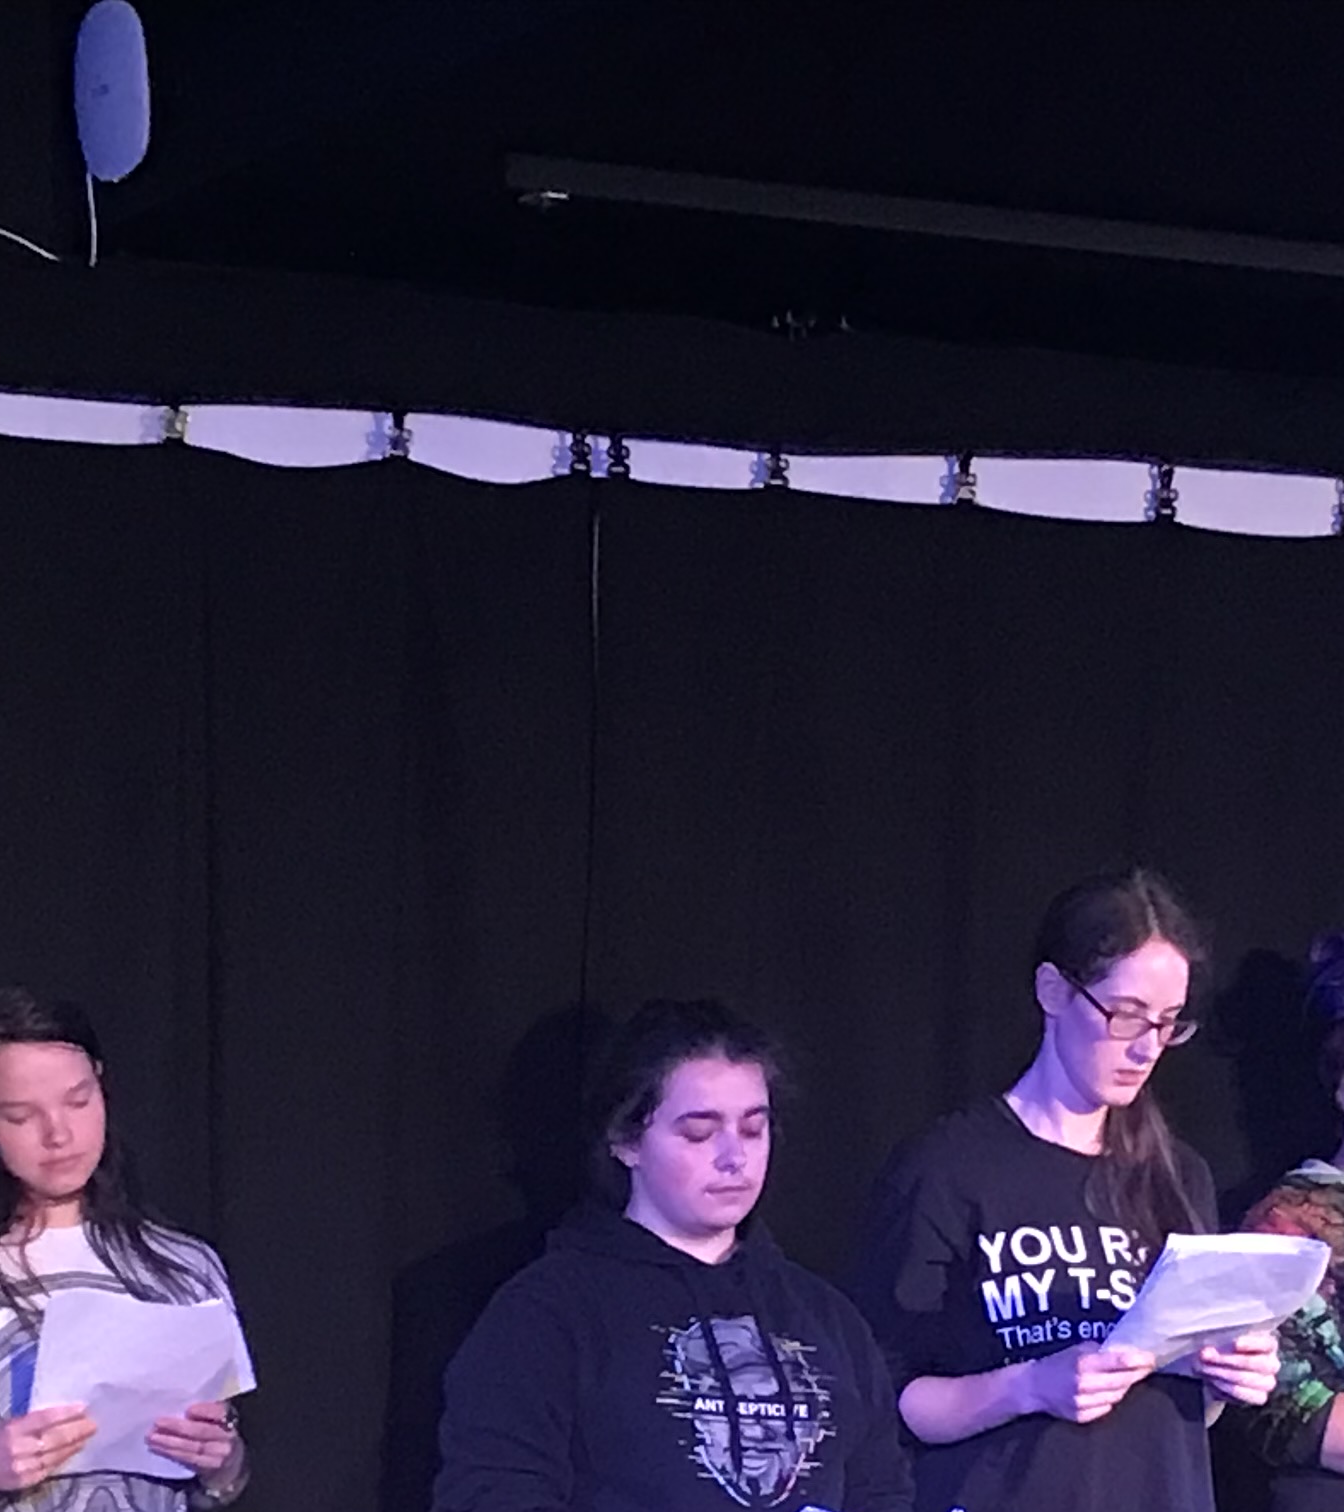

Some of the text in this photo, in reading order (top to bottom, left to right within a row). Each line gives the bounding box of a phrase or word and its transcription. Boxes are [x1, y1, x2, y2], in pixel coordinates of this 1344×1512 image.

[978, 1225, 1087, 1274] YOU
[981, 1267, 1137, 1323] MY T-S
[996, 1316, 1072, 1350] That's
